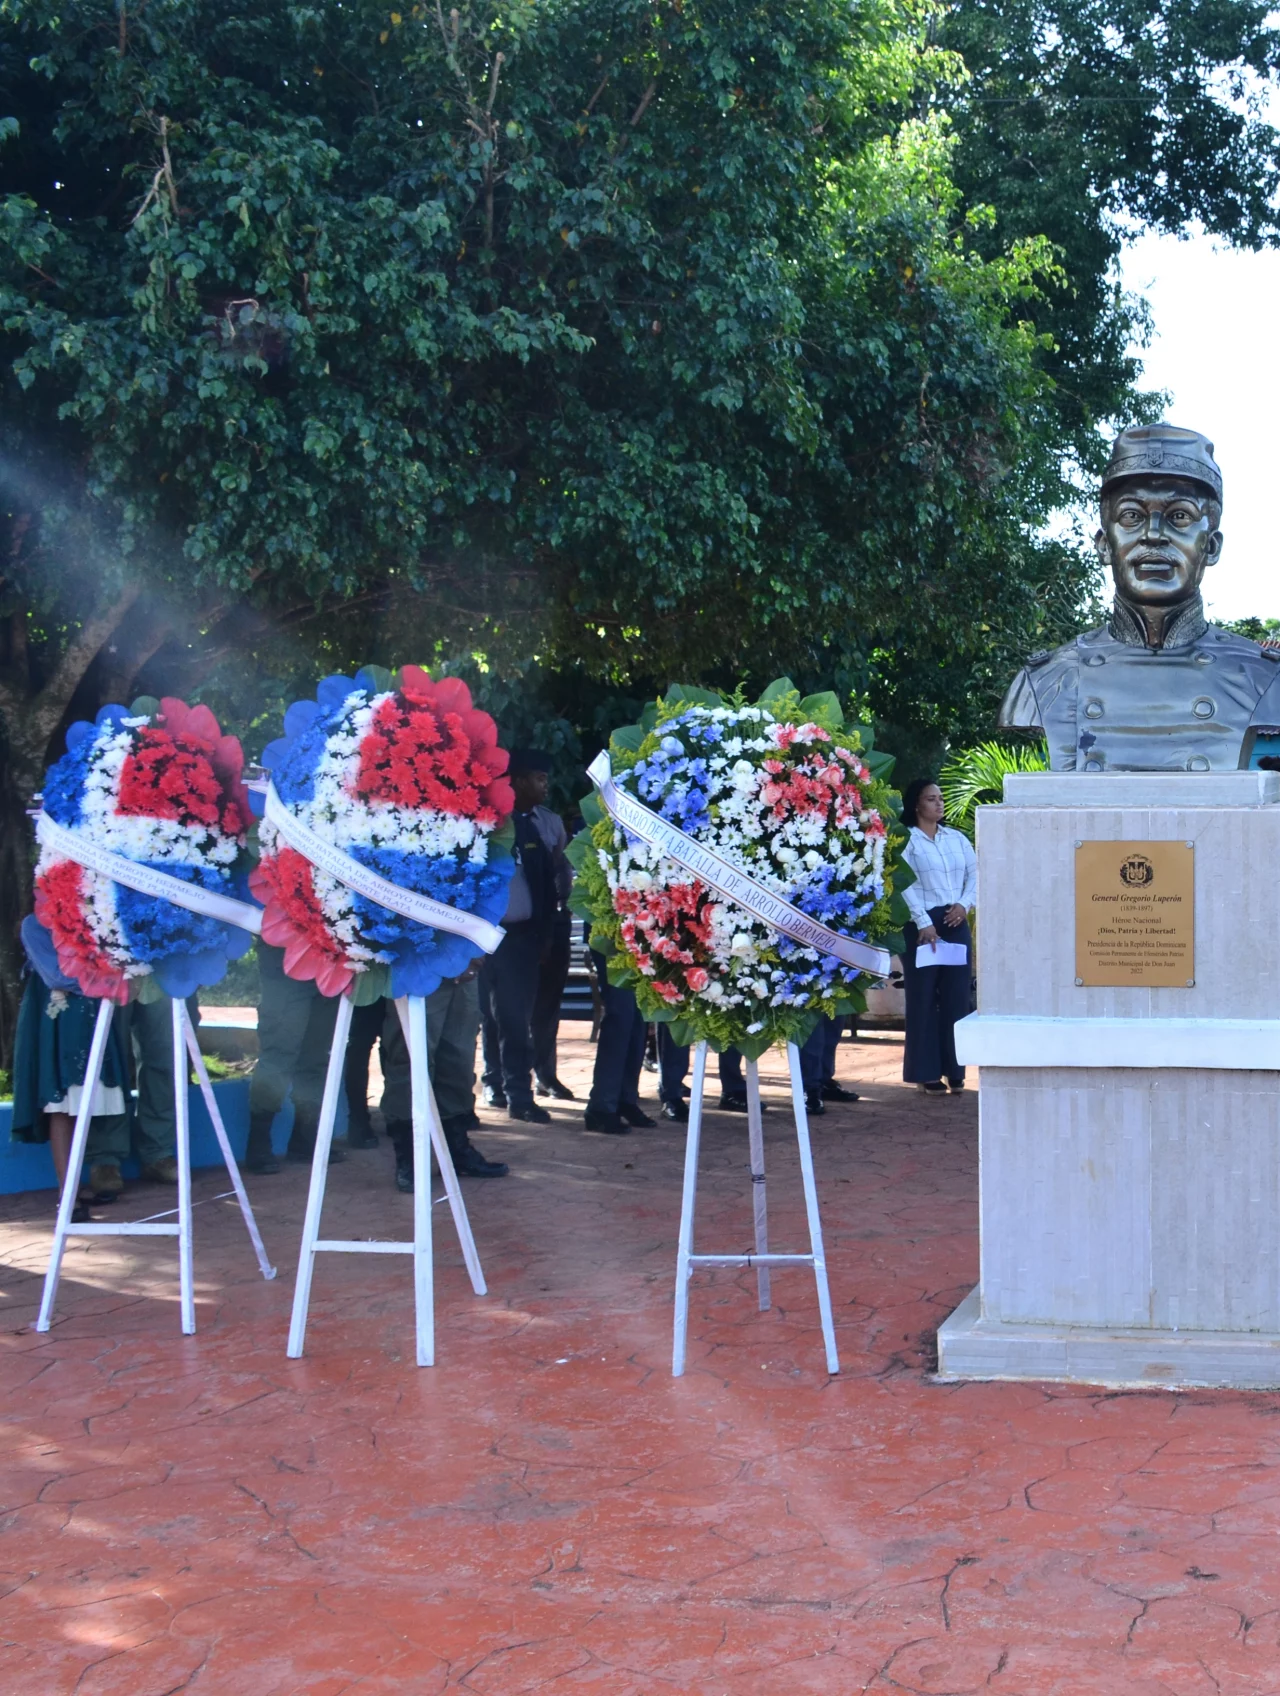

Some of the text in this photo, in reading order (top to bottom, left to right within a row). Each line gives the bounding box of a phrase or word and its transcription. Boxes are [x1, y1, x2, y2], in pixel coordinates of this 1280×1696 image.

[64, 835, 97, 856] BATALLA
[113, 861, 153, 880] ARROYO
[155, 877, 206, 900] BERMEJO
[645, 819, 663, 840] DE
[658, 830, 676, 849] LA
[672, 840, 723, 881] BATALLA
[722, 874, 744, 894] DE
[741, 888, 793, 927] ARROLLO
[111, 868, 147, 886] MONTE
[147, 882, 178, 899] PLATA
[316, 844, 353, 872] BATALLA
[355, 870, 370, 881] DE
[371, 880, 413, 903] ARROYO
[414, 900, 466, 924] BERMEJO
[325, 860, 346, 878] CIVIL
[348, 876, 381, 898] MONTE
[382, 896, 412, 912] PLATA
[1091, 893, 1182, 904] General Gregorio Luperón
[1111, 916, 1132, 924] Héroe
[1097, 927, 1117, 935] ¡Dios,
[1087, 940, 1116, 948] Presidencia
[1130, 940, 1155, 949] República
[1118, 960, 1144, 968] Municipal
